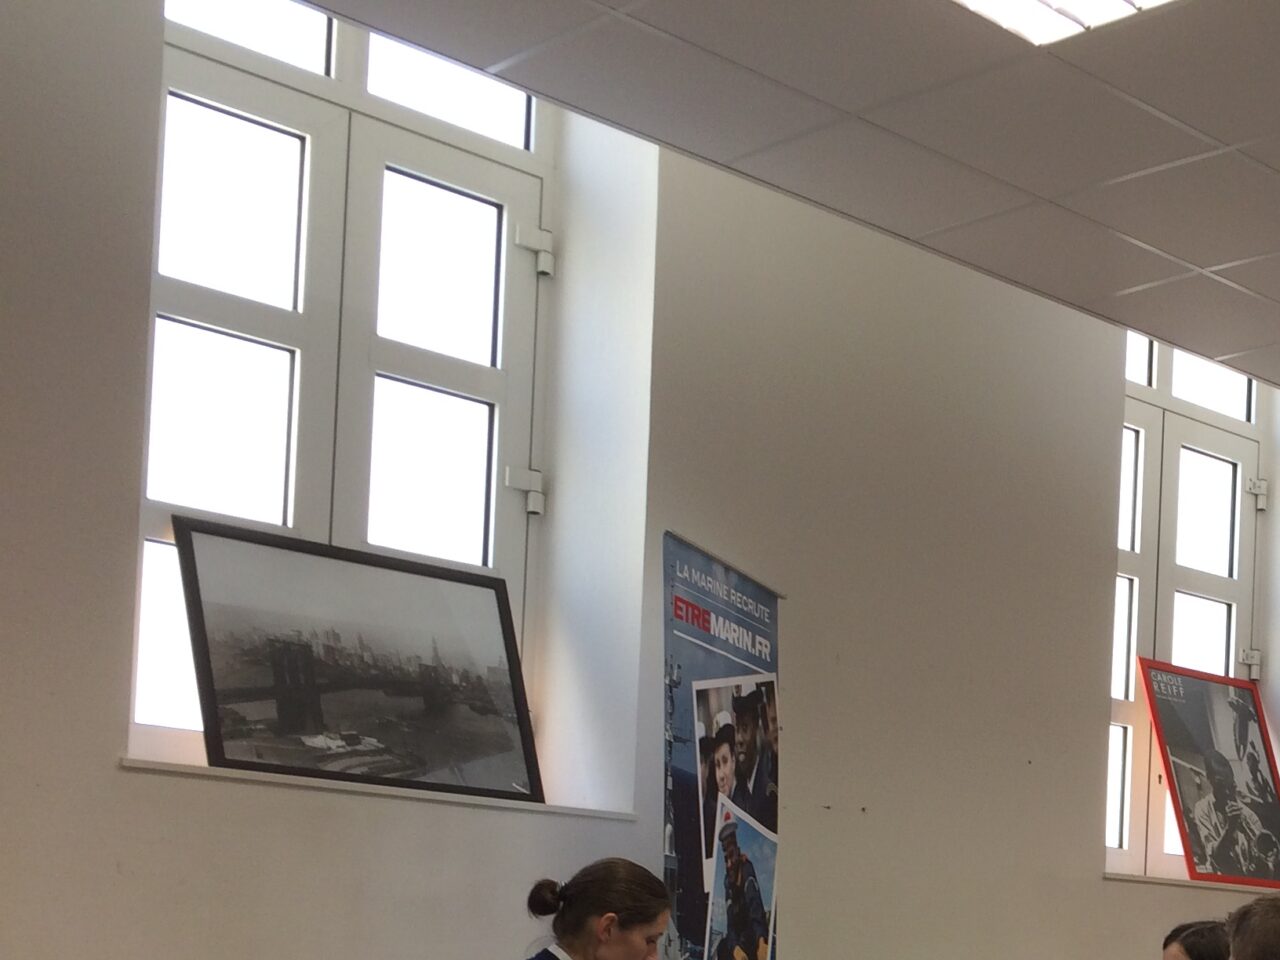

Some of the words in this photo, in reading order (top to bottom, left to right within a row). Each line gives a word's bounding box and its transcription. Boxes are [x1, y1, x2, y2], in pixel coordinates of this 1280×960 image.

[676, 560, 690, 582] LA
[691, 567, 729, 601] MARINE
[730, 588, 770, 623] RECRUTE
[1153, 681, 1185, 697] REIFF
